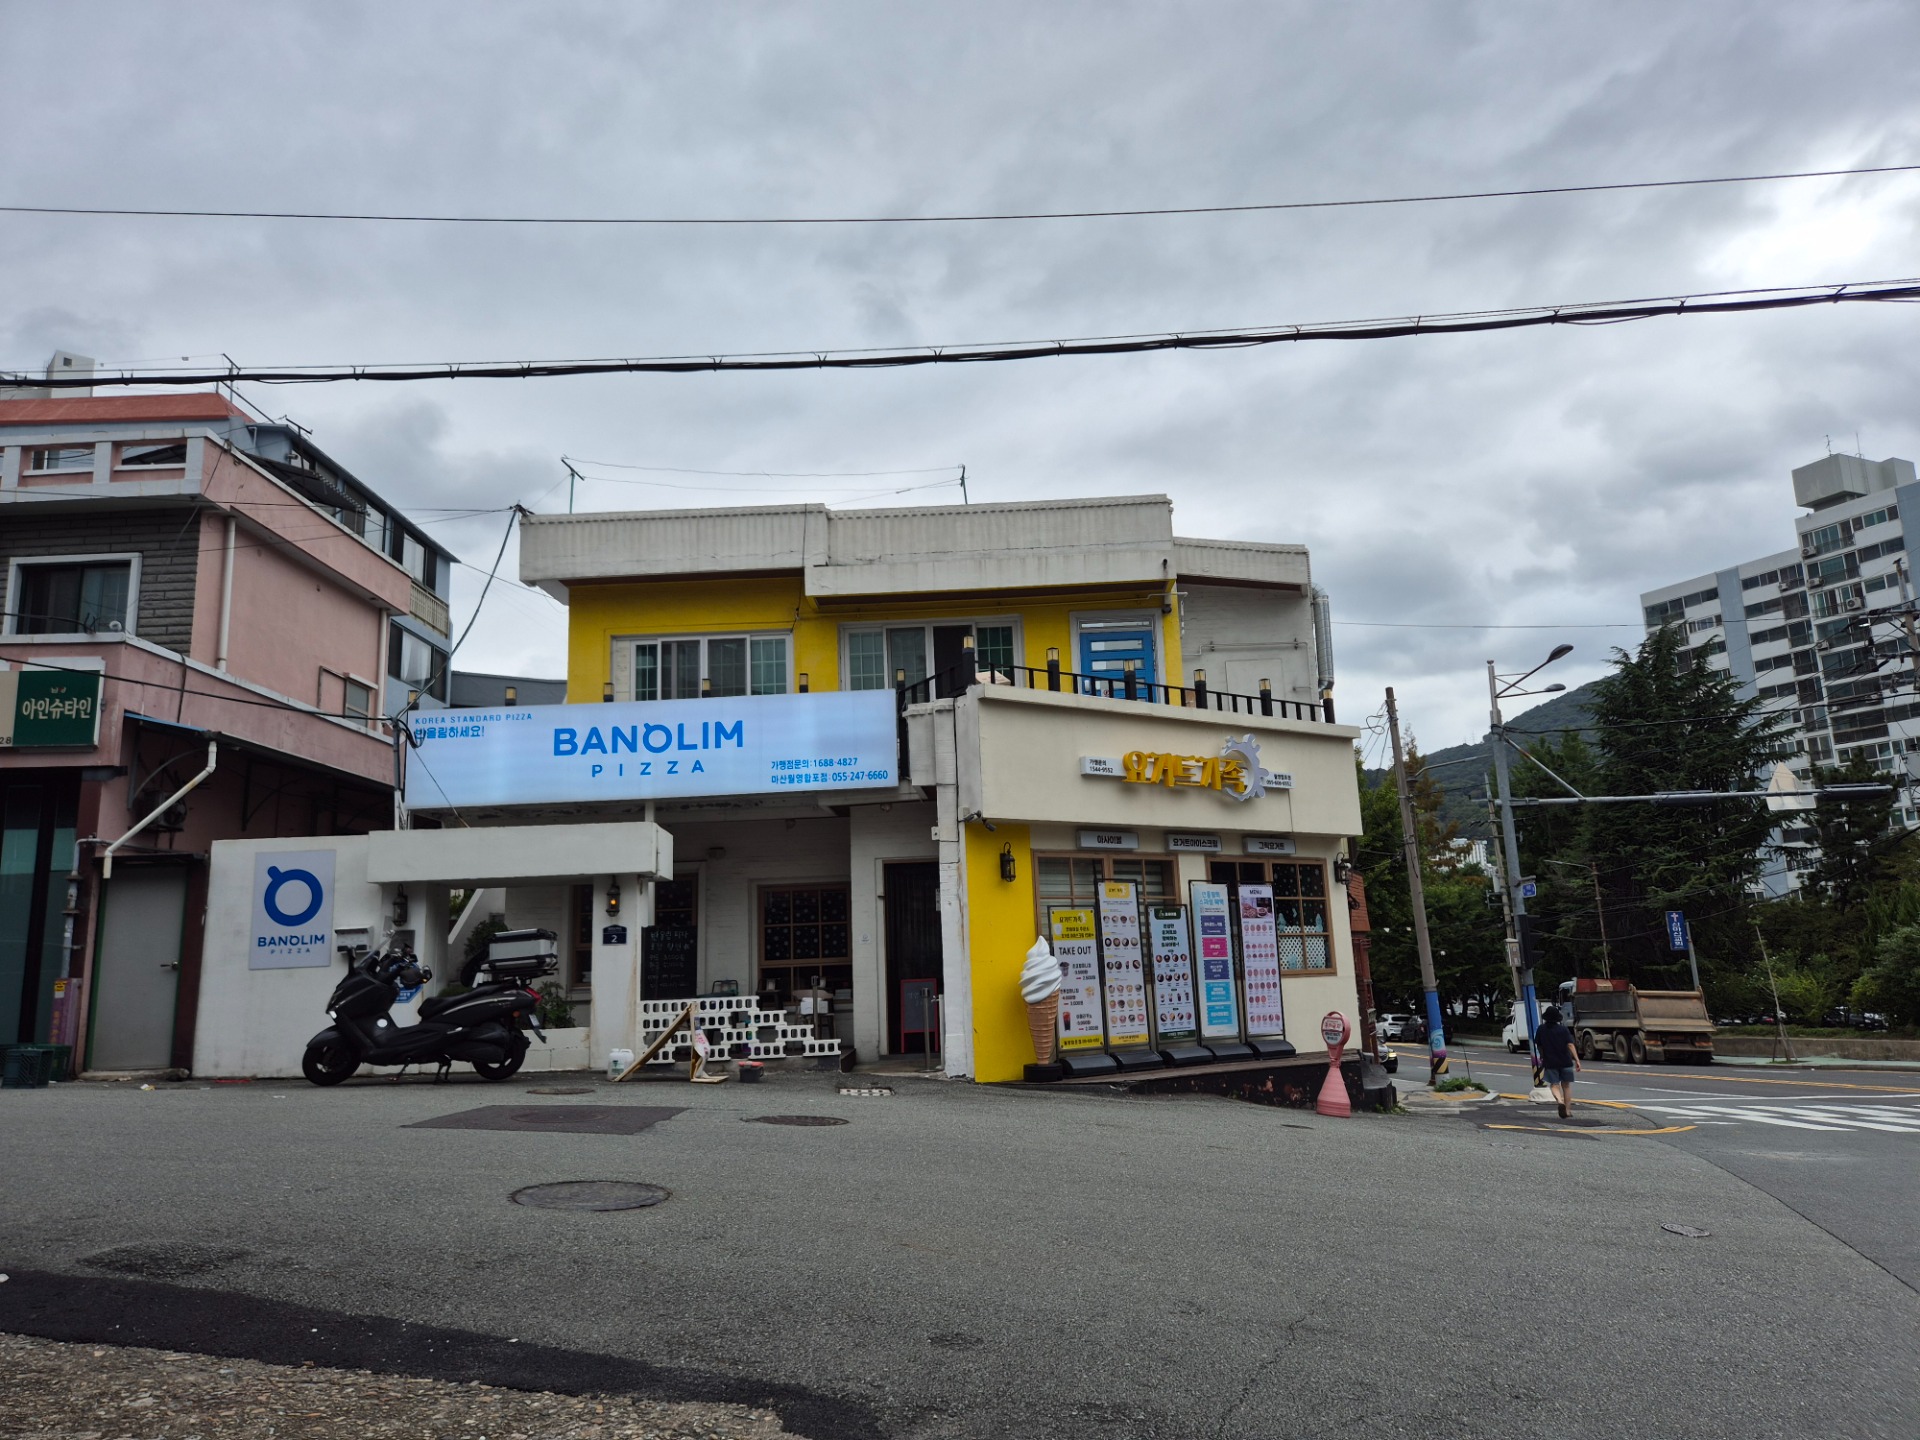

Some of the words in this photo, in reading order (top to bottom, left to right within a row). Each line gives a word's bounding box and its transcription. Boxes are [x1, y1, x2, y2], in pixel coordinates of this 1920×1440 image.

[22, 697, 92, 719] 아인슈타인
[415, 717, 446, 725] KOREA
[450, 714, 502, 723] STANDARD
[505, 713, 532, 721] PIZZA
[414, 725, 485, 740] 반올림하세요!
[553, 720, 743, 756] BANOLIM
[591, 759, 705, 778] PIZZA
[1172, 838, 1219, 849] 요거트아이스크림
[257, 934, 325, 947] BANOLIM
[611, 934, 618, 943] 2
[270, 947, 311, 955] PIZZA
[1059, 946, 1076, 956] TAKE
[1077, 946, 1092, 955] OUT
